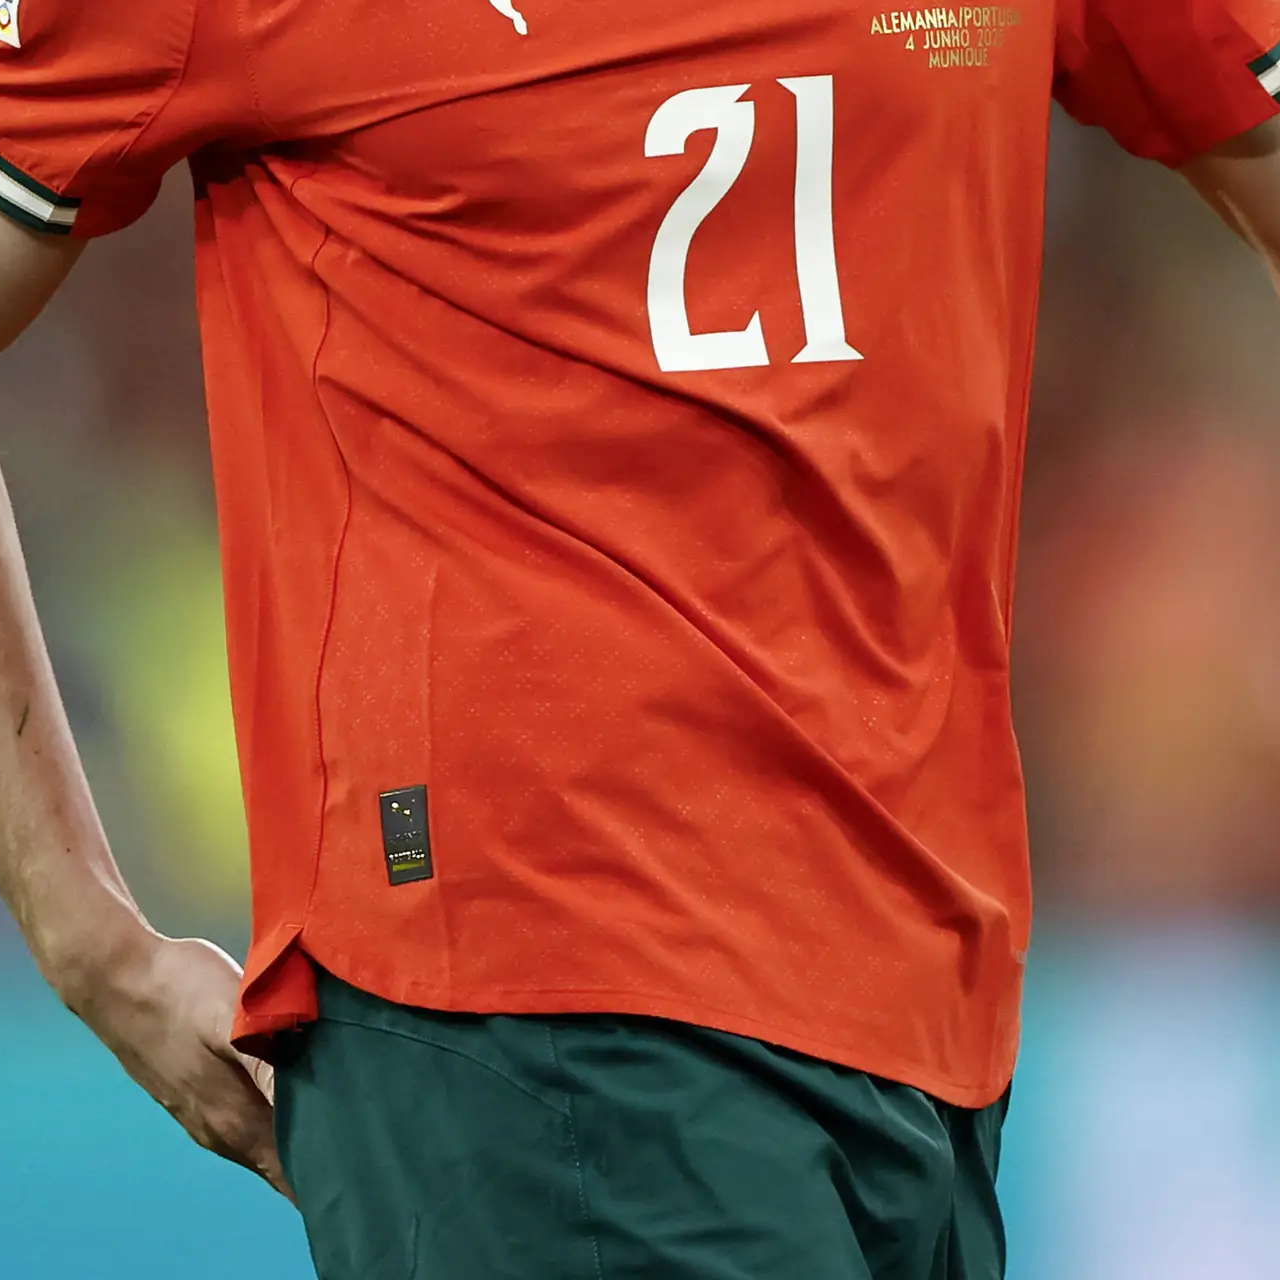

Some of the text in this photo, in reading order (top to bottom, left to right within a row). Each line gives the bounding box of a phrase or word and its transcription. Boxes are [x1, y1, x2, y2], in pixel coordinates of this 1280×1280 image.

[905, 33, 915, 51] 4
[923, 28, 970, 50] JUNHO
[644, 74, 865, 372] 21
